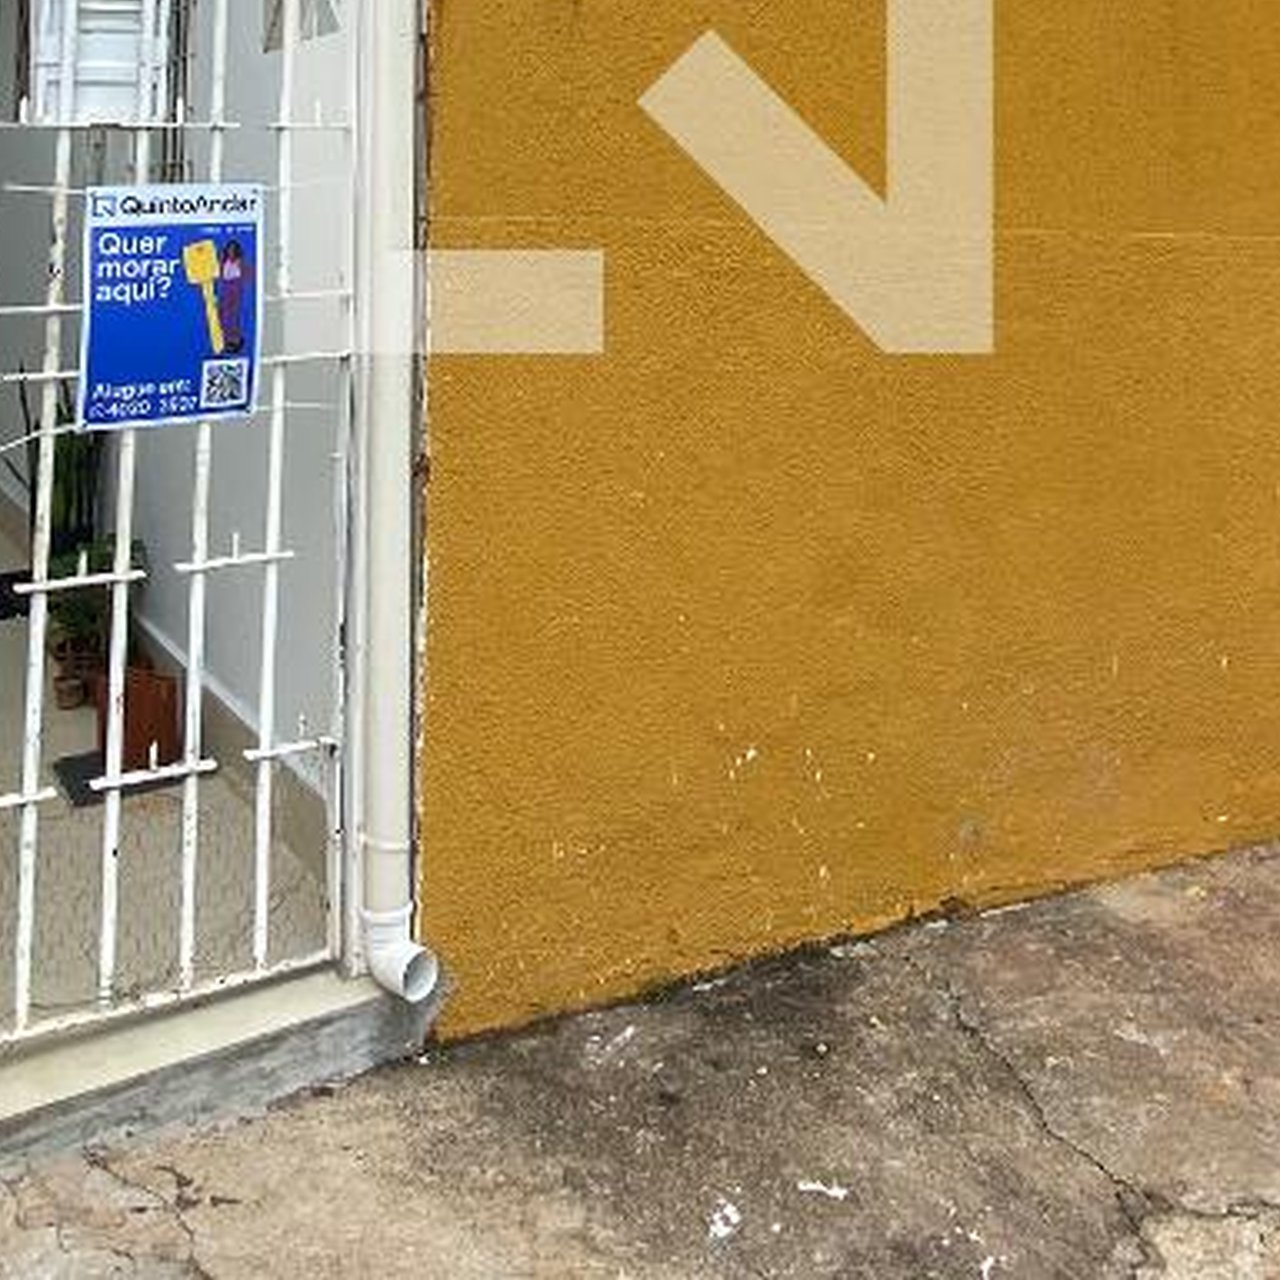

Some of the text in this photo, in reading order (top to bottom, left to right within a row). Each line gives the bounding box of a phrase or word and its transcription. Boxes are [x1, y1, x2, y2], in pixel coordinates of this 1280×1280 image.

[120, 194, 258, 216] QuintoAndar
[98, 232, 169, 256] Quer
[97, 258, 181, 279] morar
[95, 278, 172, 306] aqui?
